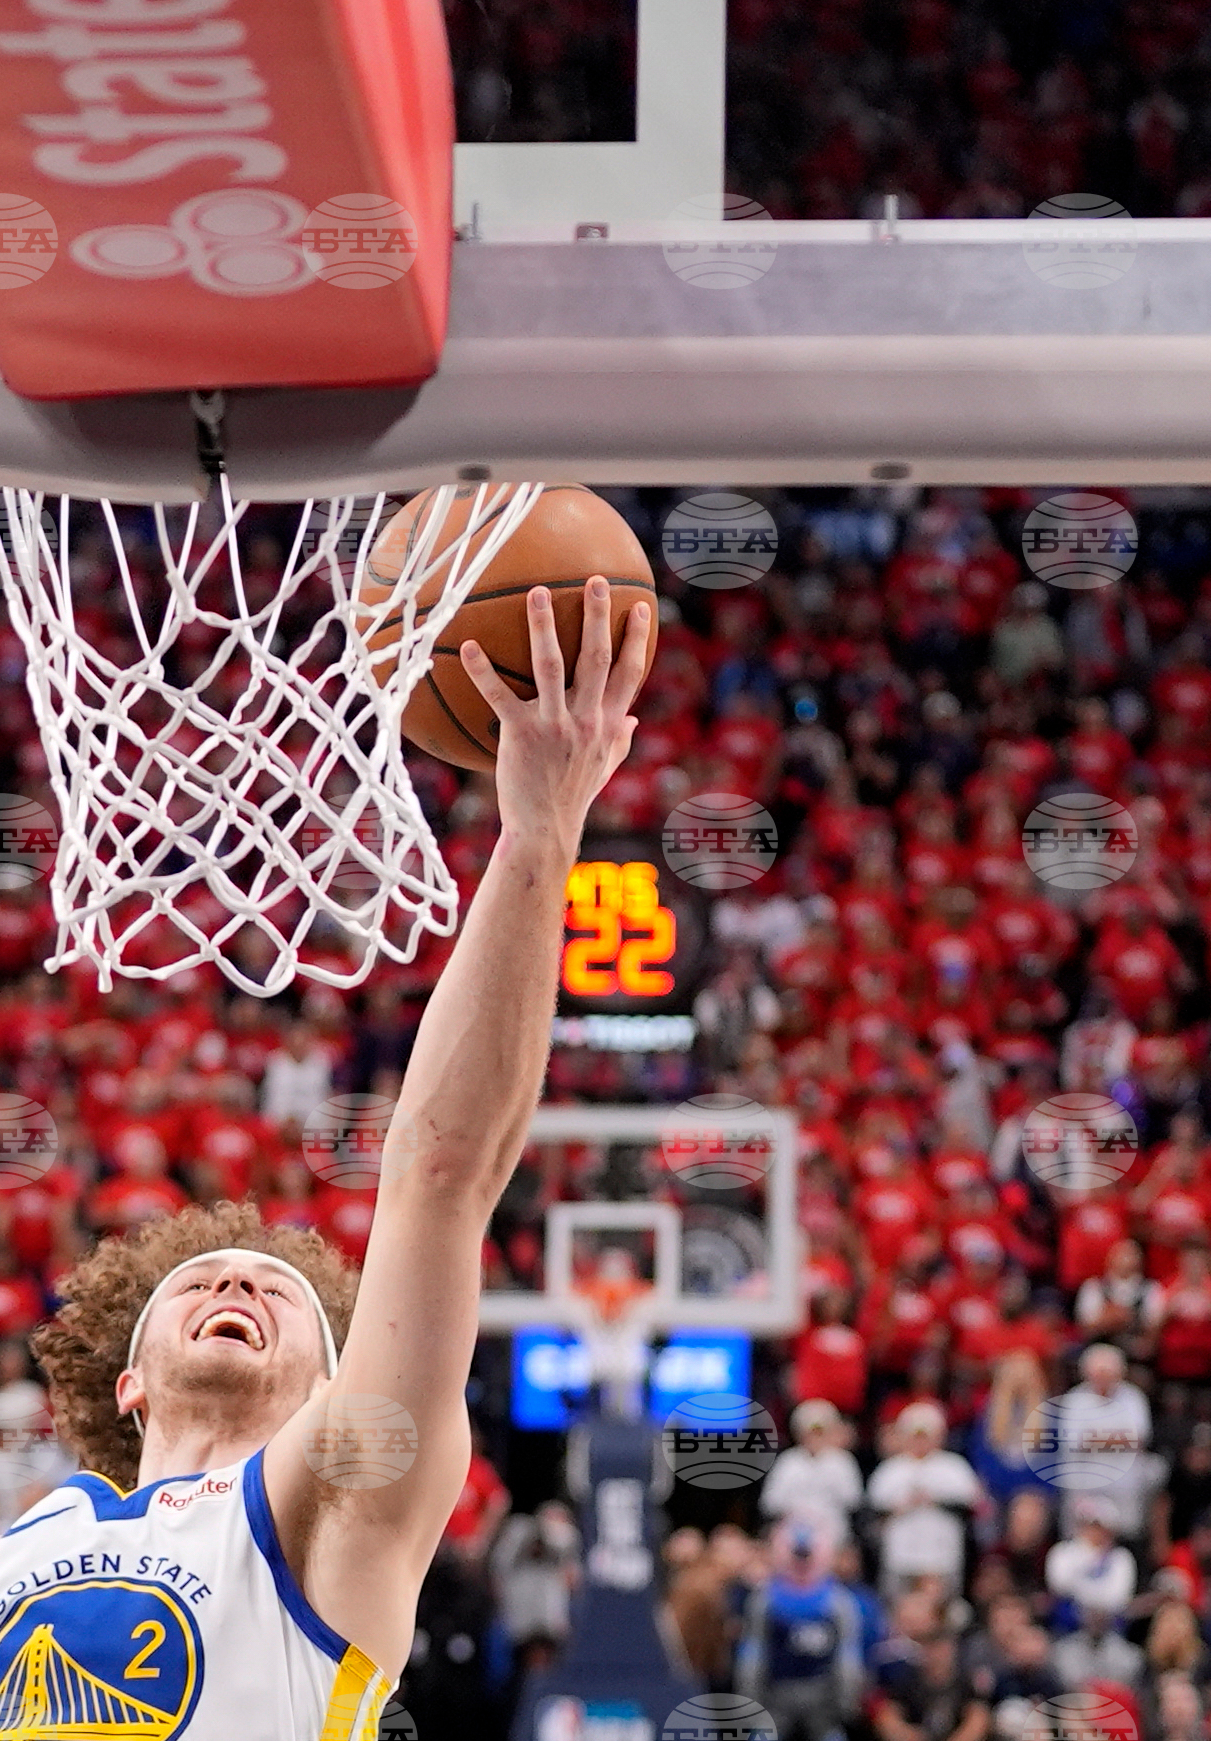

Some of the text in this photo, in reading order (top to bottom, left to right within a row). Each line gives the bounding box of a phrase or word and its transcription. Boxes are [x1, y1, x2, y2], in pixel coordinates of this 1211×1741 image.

[563, 905, 677, 996] 22
[137, 1555, 212, 1605] STATE
[124, 1620, 167, 1680] 2
